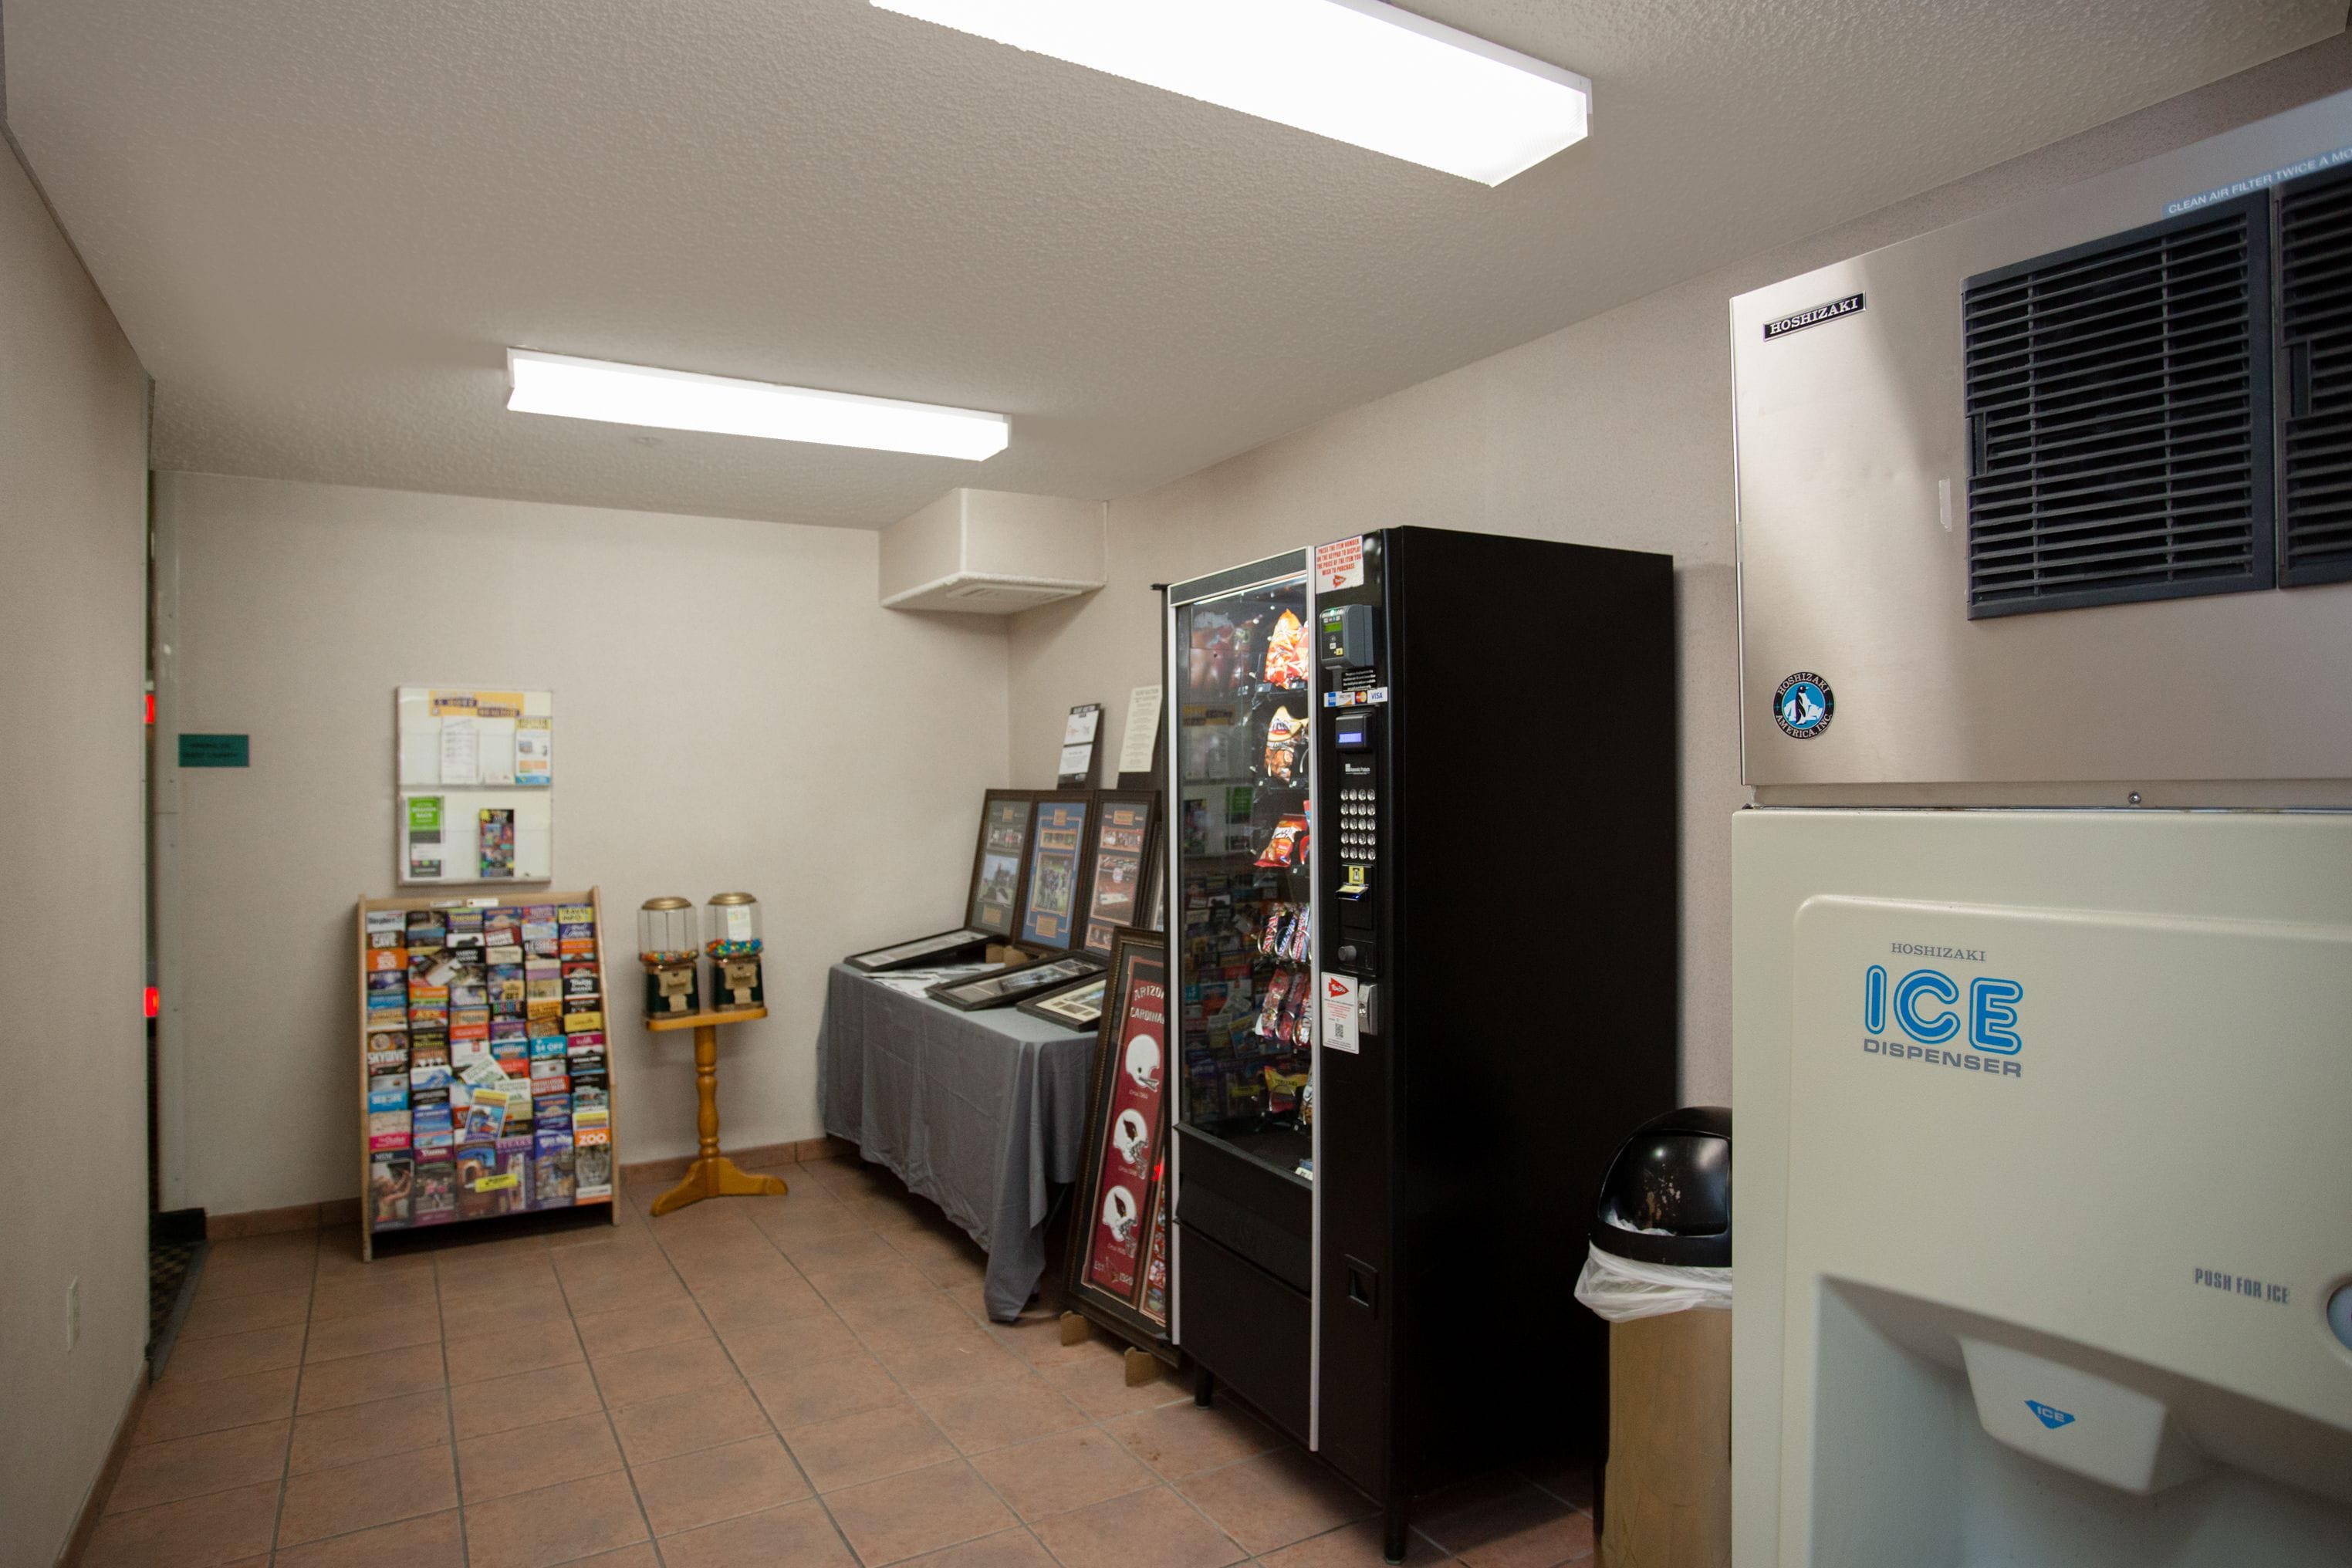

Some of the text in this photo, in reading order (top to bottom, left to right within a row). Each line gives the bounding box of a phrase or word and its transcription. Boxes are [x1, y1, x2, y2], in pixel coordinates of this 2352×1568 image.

[2168, 195, 2207, 215] CLEAN
[2209, 187, 2229, 202] AIR
[2232, 174, 2273, 193] FILTER
[2275, 159, 2316, 180] TWICE
[2319, 156, 2329, 167] A
[1769, 297, 1859, 335] HOSHIZAKI
[1776, 673, 1830, 696] HOSHIZAKI
[1891, 942, 1986, 962] HOSHIZAKI
[1865, 965, 2023, 1056] ICE
[547, 1042, 563, 1051] OFF
[1864, 1038, 2023, 1078] DISPENSER
[579, 1133, 607, 1144] ZOO
[2195, 1268, 2289, 1304] PUSH FOR ICE
[2037, 1406, 2065, 1423] ICE
